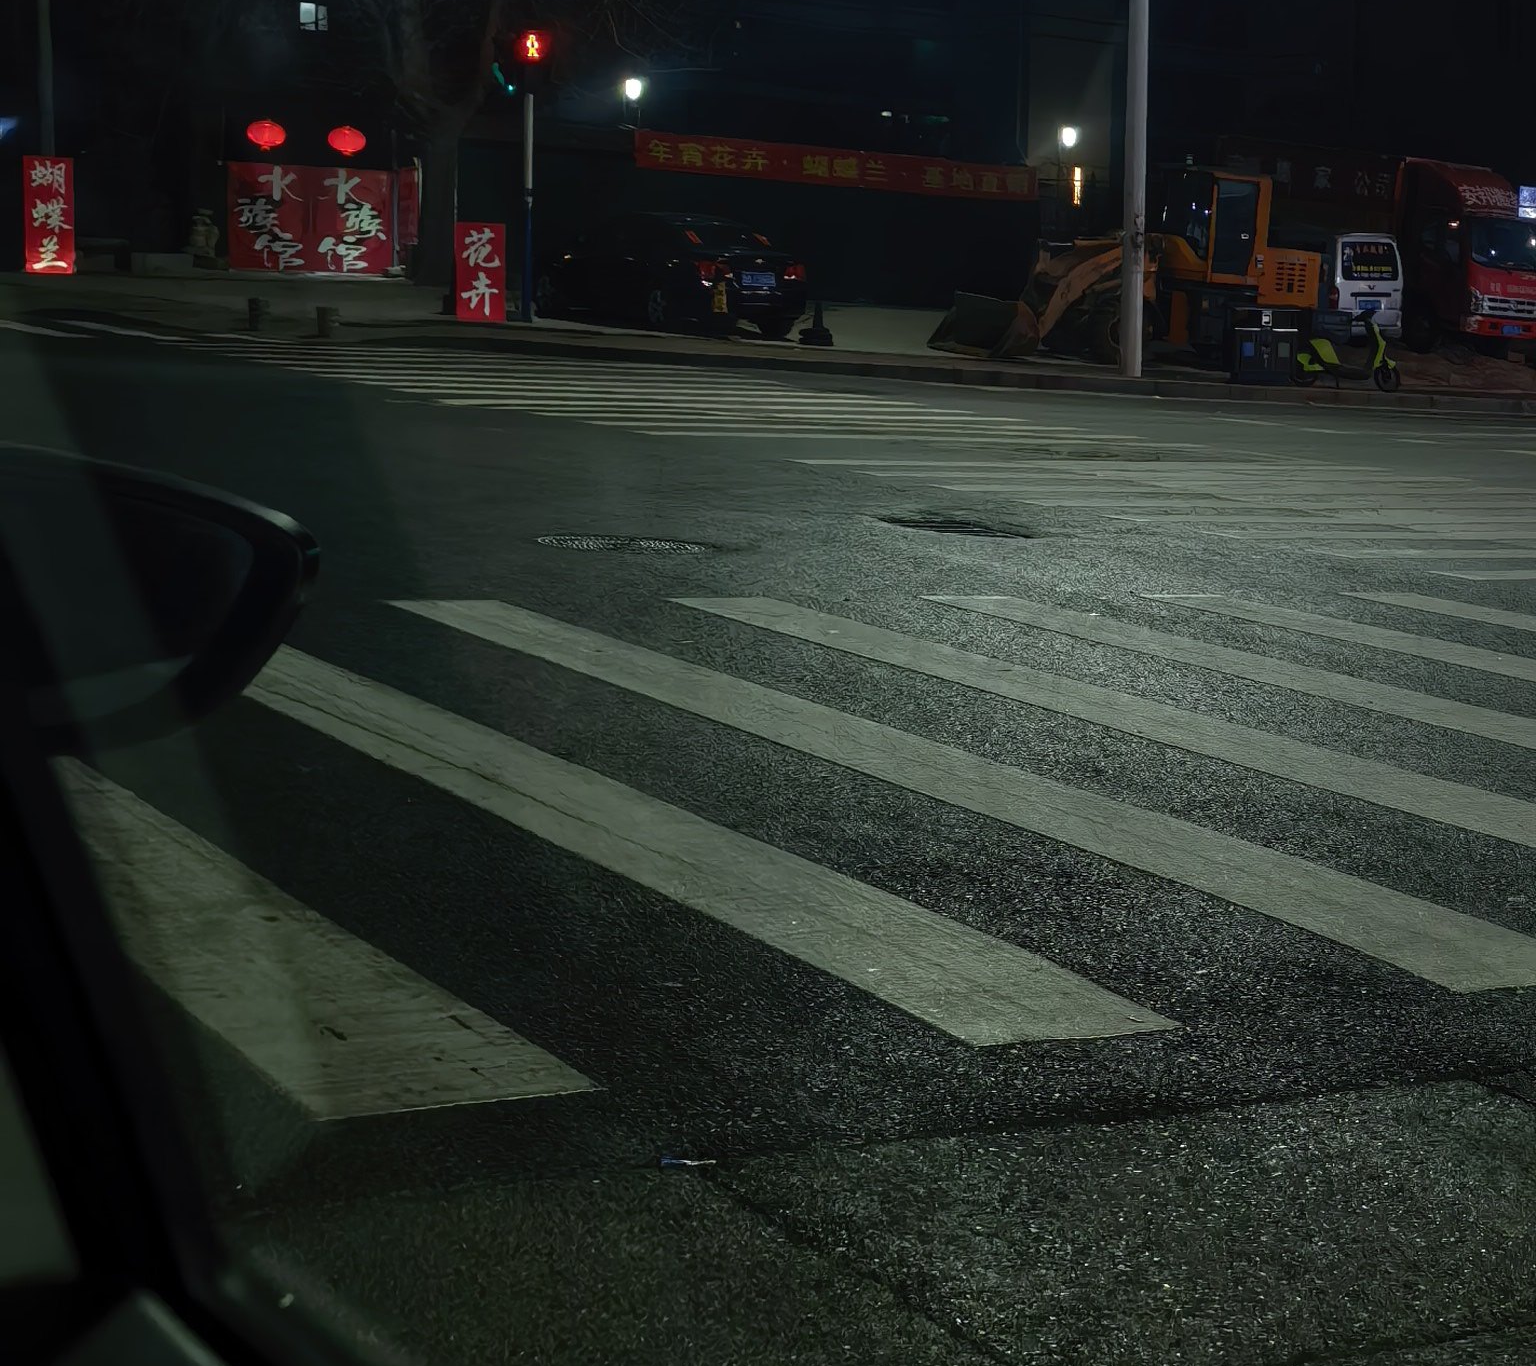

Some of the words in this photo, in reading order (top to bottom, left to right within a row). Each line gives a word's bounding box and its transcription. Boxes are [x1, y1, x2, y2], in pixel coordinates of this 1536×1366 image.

[30, 160, 72, 270] 蝴蝶兰
[233, 165, 306, 272] 水族馆
[316, 169, 387, 273] 水族馆
[461, 227, 502, 317] 花卉
